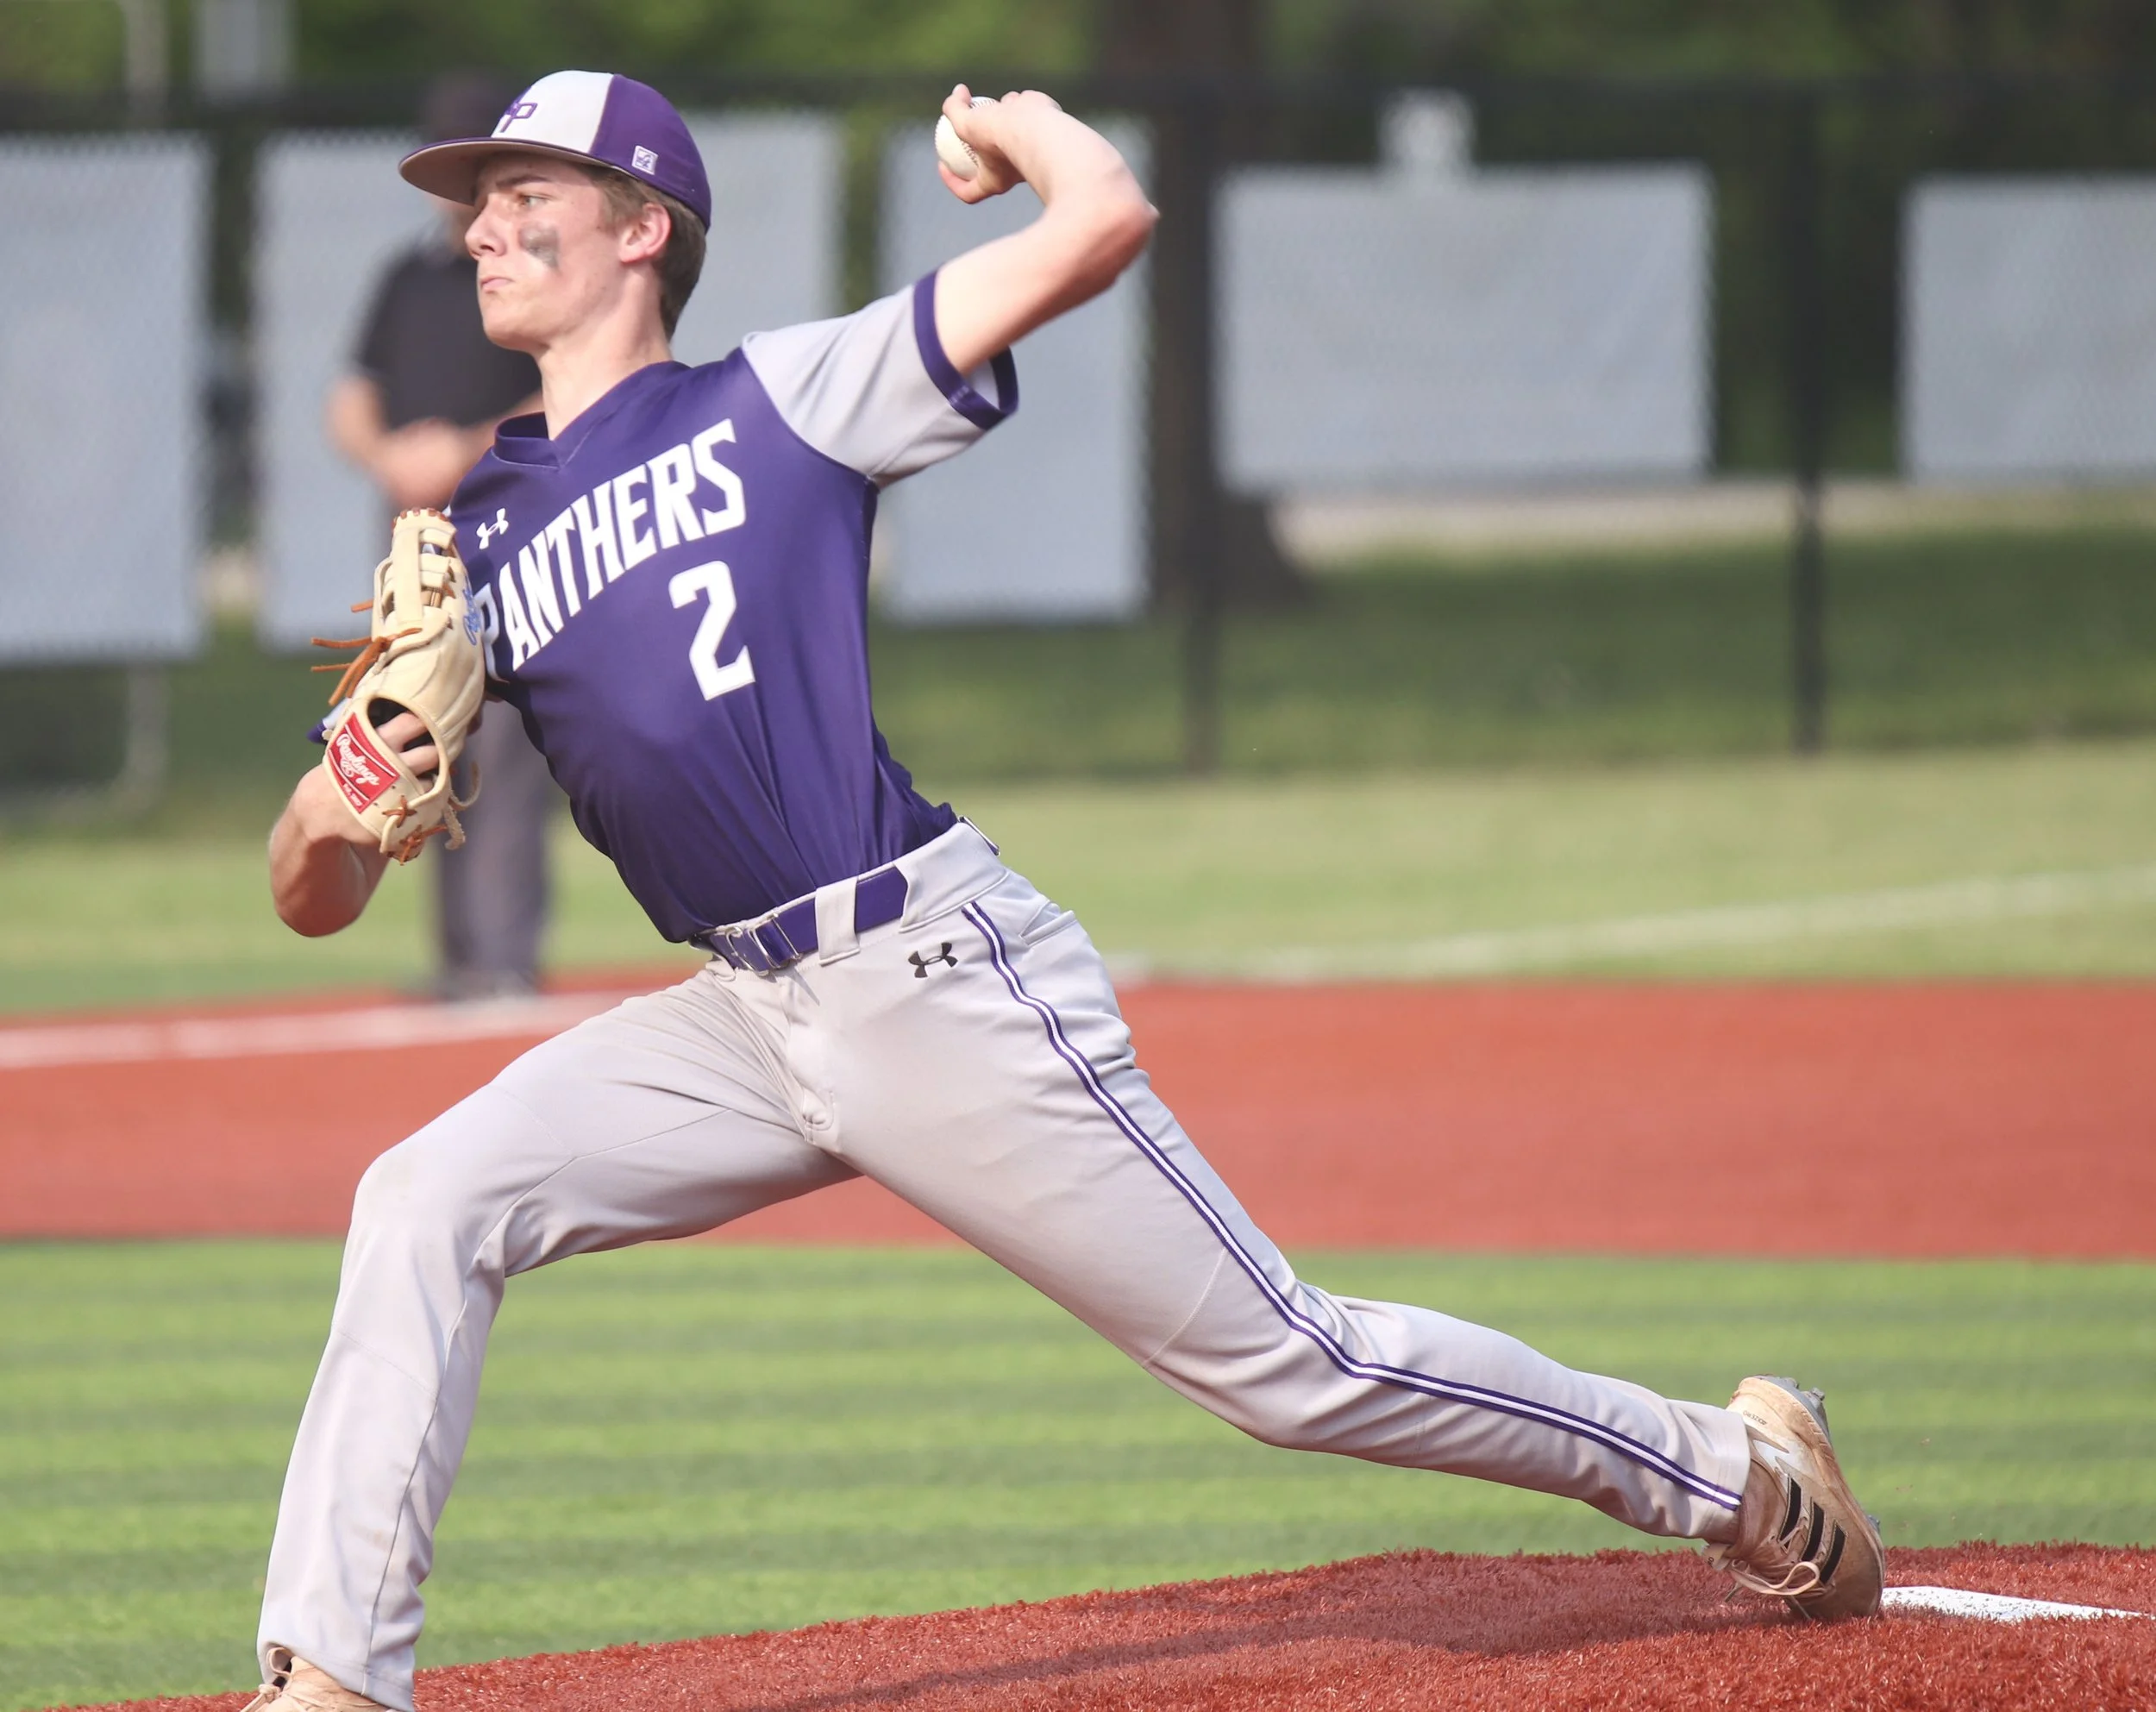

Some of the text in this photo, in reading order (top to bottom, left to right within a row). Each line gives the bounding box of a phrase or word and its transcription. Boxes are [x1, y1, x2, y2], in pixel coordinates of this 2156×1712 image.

[473, 418, 747, 682] PANTHERS
[668, 560, 756, 701] 2
[336, 733, 379, 786] Rawlings
